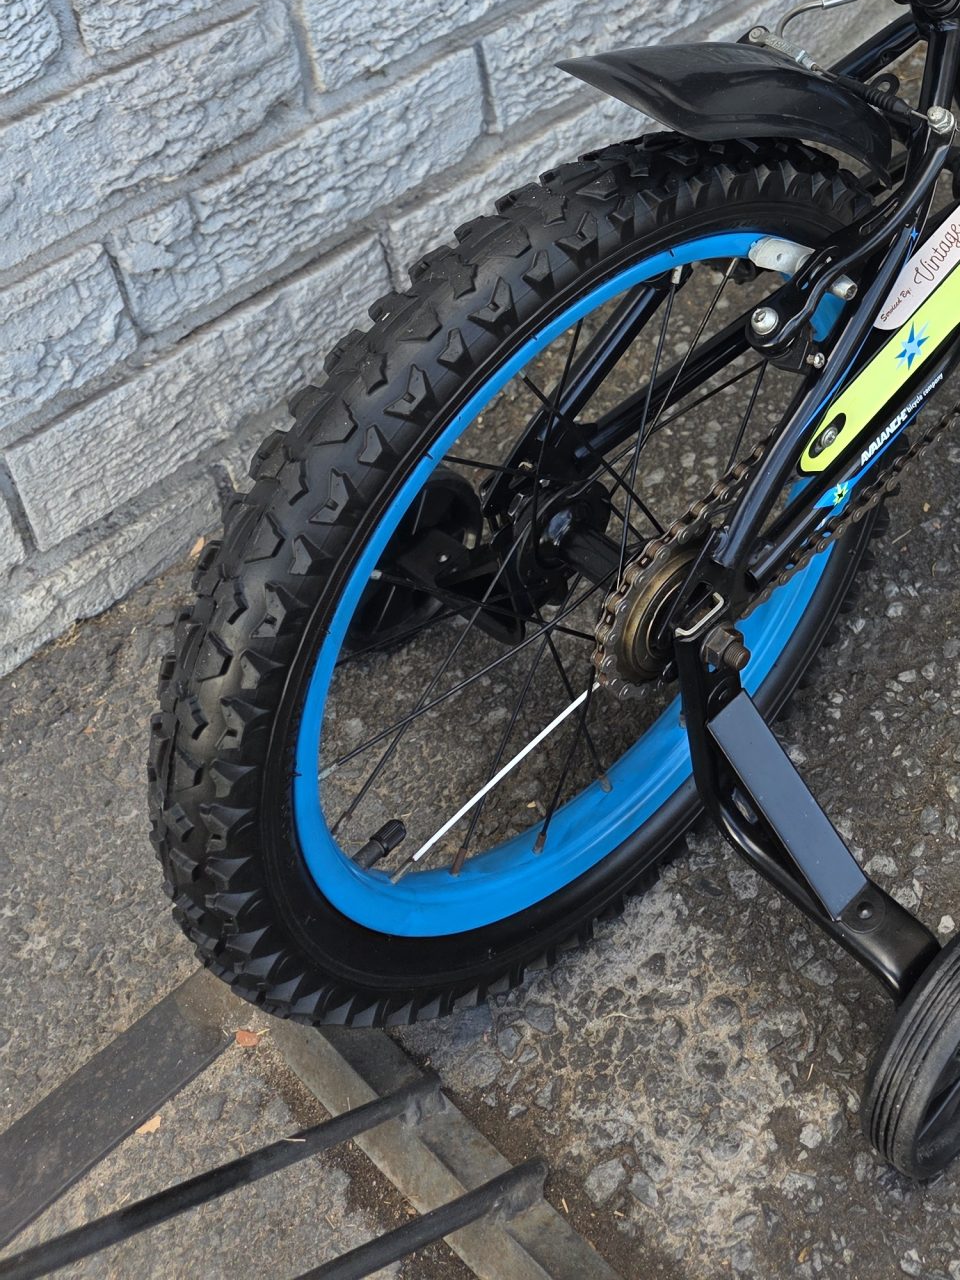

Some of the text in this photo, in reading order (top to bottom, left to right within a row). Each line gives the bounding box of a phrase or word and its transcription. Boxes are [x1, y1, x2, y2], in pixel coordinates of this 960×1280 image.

[861, 372, 944, 466] AVALANCHE bicycle company
